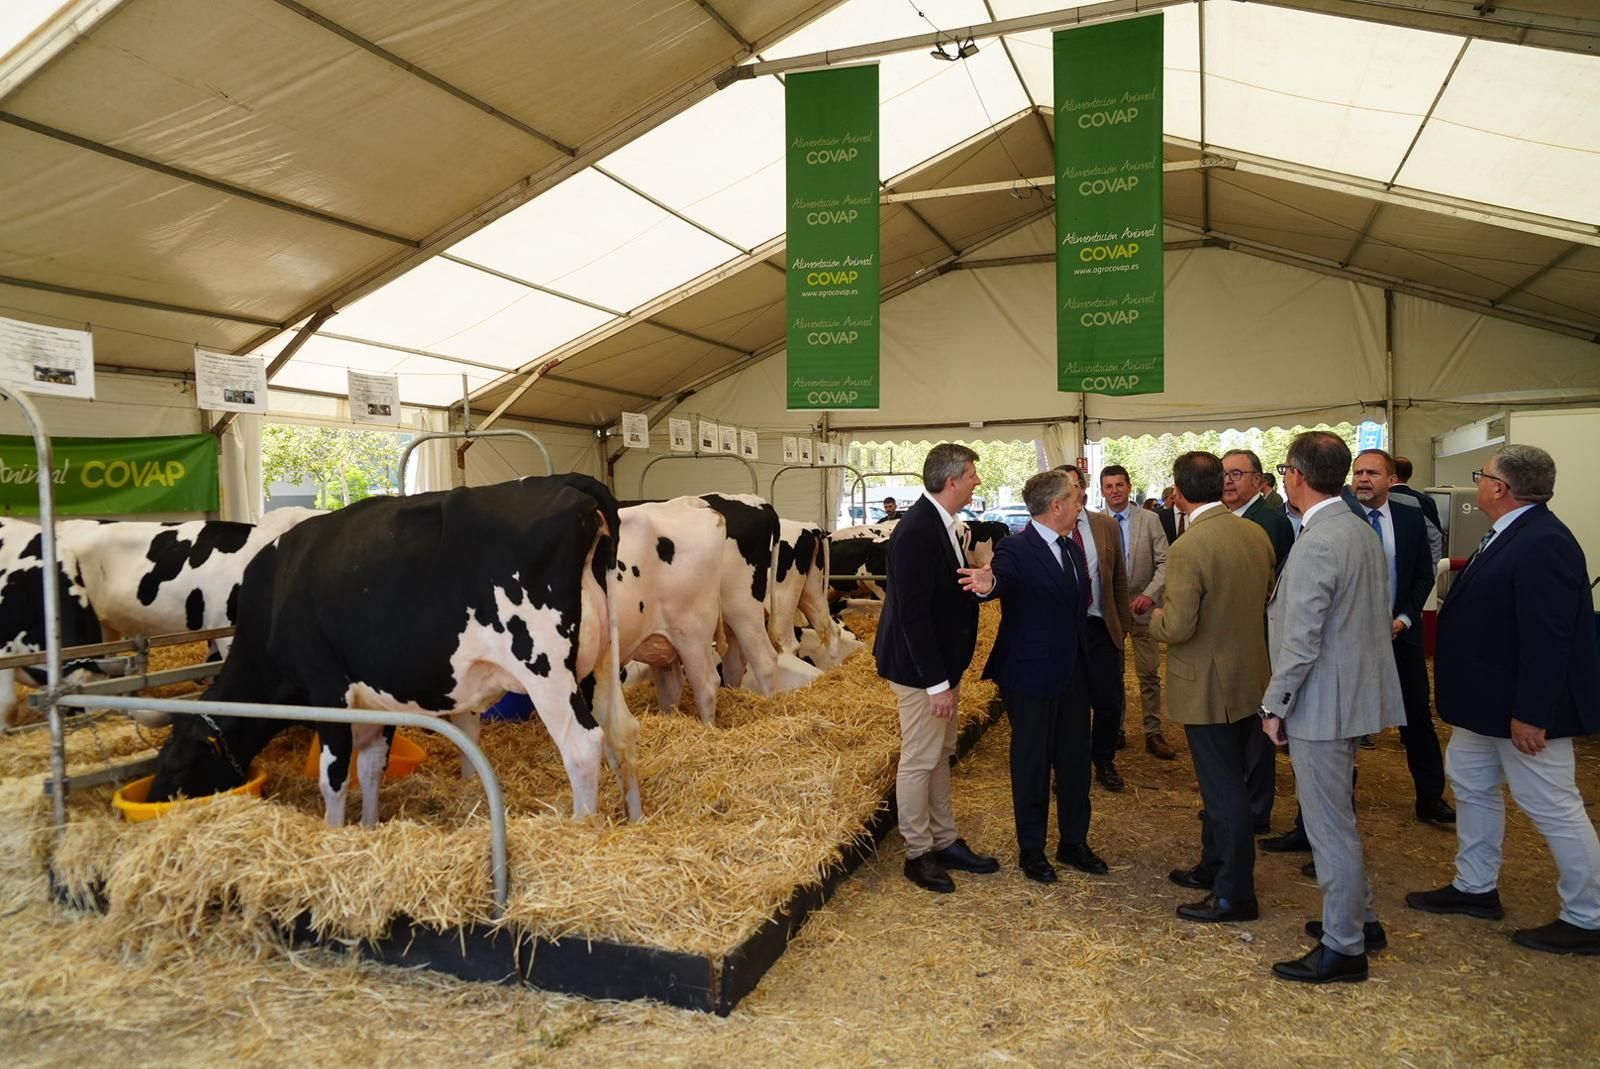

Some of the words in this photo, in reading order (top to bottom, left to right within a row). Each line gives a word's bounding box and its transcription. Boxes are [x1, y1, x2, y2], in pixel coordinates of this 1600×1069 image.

[1120, 87, 1156, 104] Animal
[1077, 107, 1138, 129] COVAP
[842, 130, 873, 145] Animal
[806, 147, 858, 165] COVAP
[1121, 155, 1156, 172] Animal
[1078, 176, 1139, 196] COVAP
[843, 192, 872, 206] Animal
[806, 209, 858, 226] COVAP
[1121, 223, 1157, 239] Animal
[1079, 243, 1139, 262] COVAP
[842, 254, 873, 267] Animal
[1073, 263, 1140, 275] www.agrocovap.es
[807, 271, 858, 286] COVAP
[801, 288, 858, 298] www.agrocovap.es
[1122, 291, 1157, 306] Animal
[843, 314, 873, 327] Animal
[1080, 309, 1139, 327] COVAP
[807, 331, 858, 346] COVAP
[1122, 358, 1156, 371] Animal
[1081, 375, 1140, 391] COVAP
[807, 391, 858, 405] COVAP
[80, 460, 185, 489] COVAP
